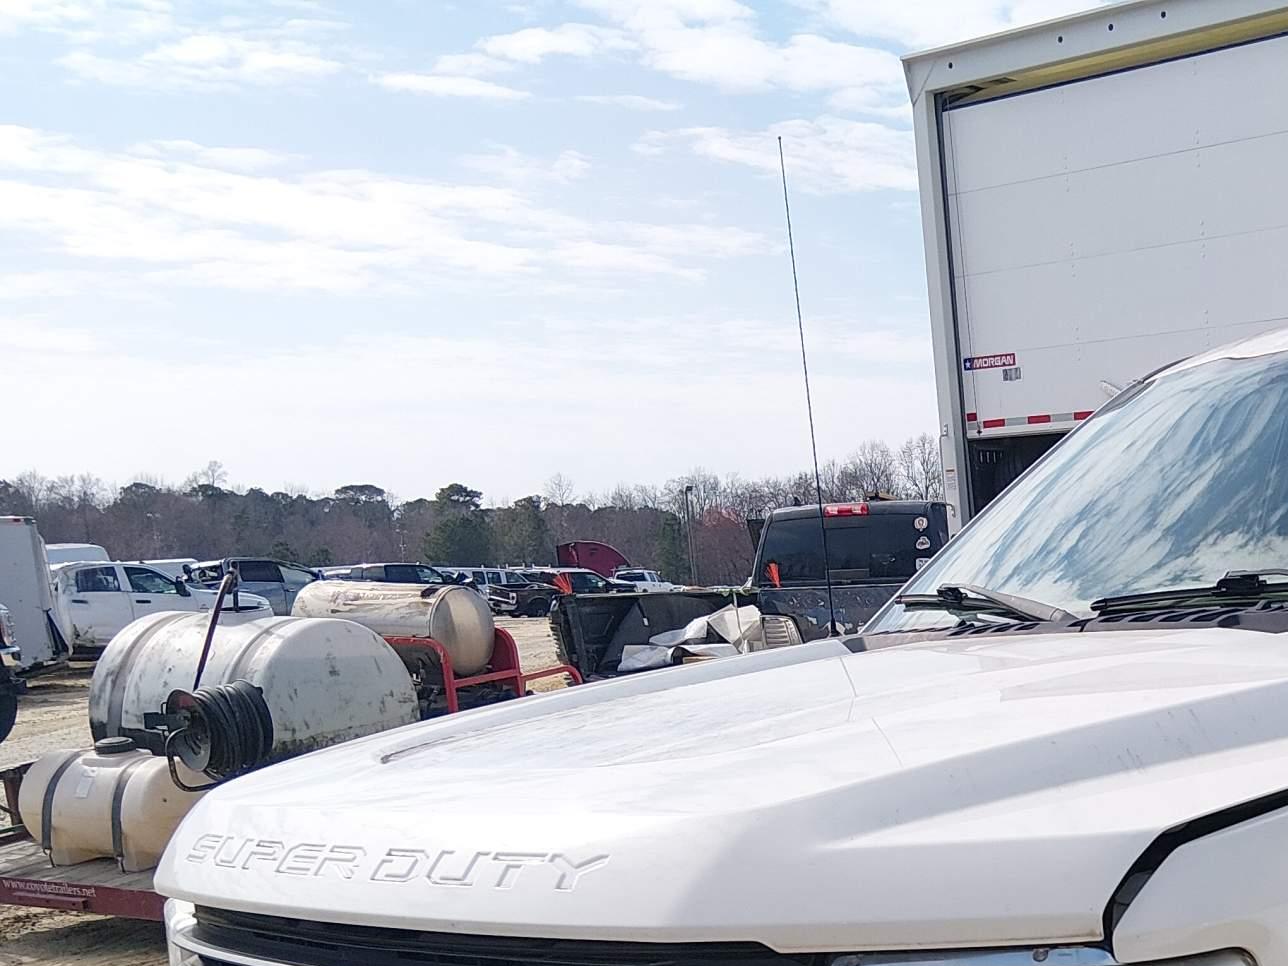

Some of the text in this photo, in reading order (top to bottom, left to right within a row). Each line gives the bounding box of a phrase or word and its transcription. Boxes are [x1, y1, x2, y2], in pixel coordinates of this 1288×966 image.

[973, 354, 1014, 368] MORGAN
[185, 833, 610, 893] SUPER DUTY
